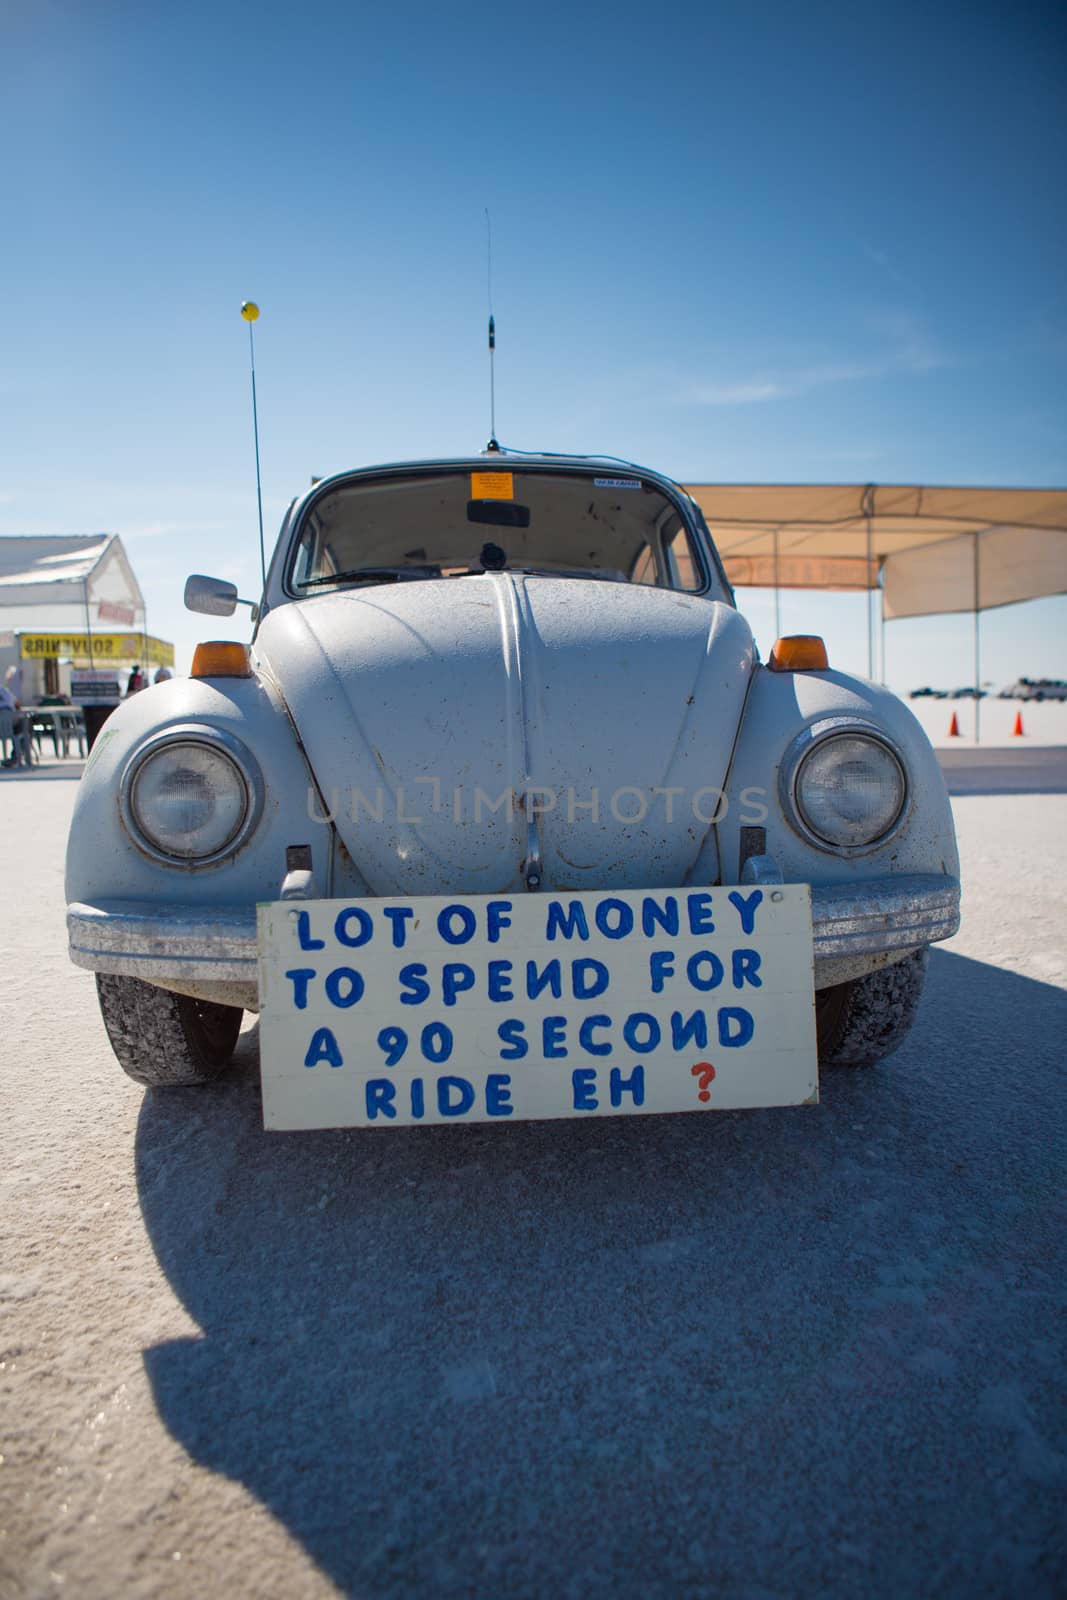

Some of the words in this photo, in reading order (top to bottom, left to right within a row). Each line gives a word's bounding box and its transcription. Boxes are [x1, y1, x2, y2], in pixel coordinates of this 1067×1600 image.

[297, 906, 415, 952] LOT
[436, 900, 513, 945] OF
[546, 889, 764, 942] MONEY
[285, 966, 366, 1010] TO
[398, 957, 611, 1008] SPEND
[649, 948, 764, 995] FOR
[304, 1027, 344, 1069] A
[376, 1021, 454, 1069] 90
[496, 1006, 756, 1061] SECOND
[364, 1073, 513, 1121] RIDE
[571, 1064, 646, 1112] EH
[691, 1062, 717, 1103] ?
